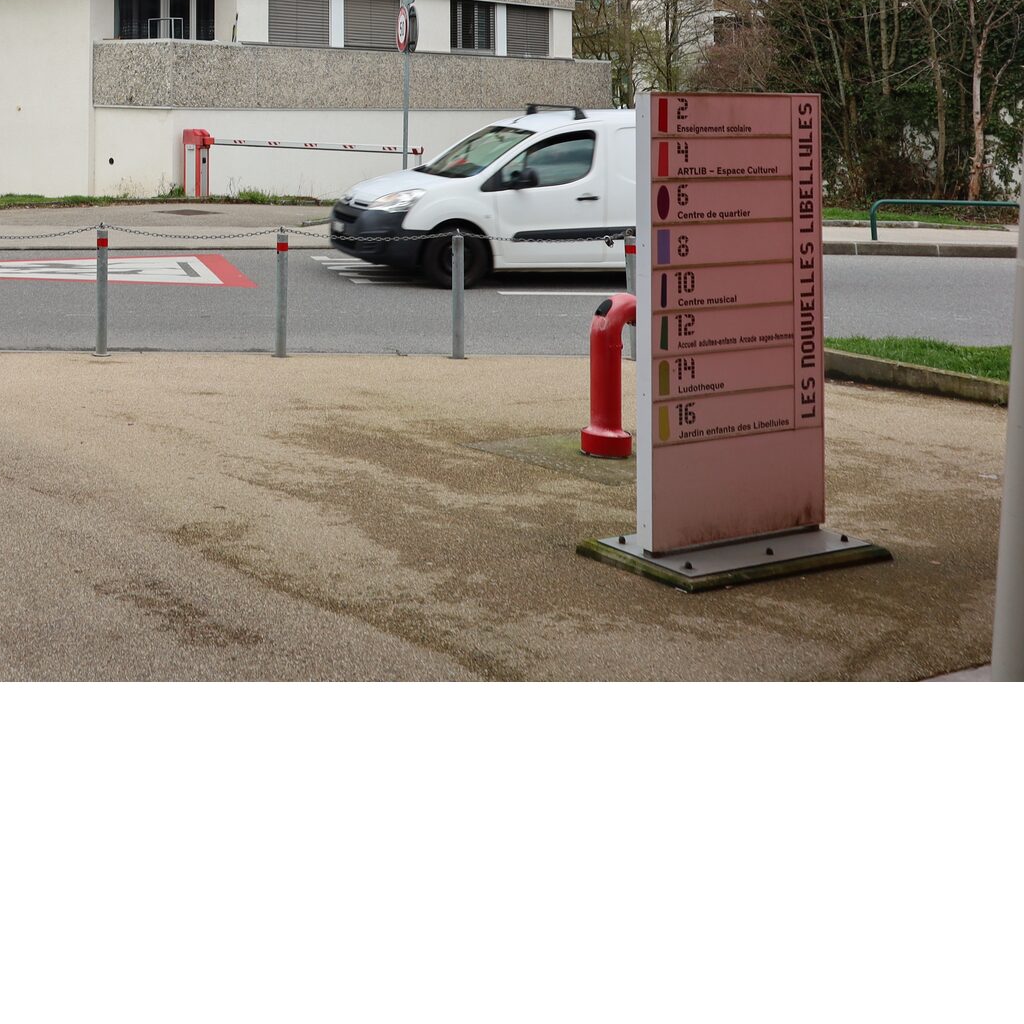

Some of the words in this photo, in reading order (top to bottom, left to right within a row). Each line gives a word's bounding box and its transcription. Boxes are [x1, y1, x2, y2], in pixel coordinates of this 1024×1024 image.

[677, 98, 688, 120] 2
[677, 125, 725, 133] Enseignement
[727, 125, 752, 133] scolaire
[677, 142, 688, 163] 4
[677, 167, 707, 176] ARTLIB
[717, 167, 745, 176] Espace
[747, 166, 778, 175] Culturel
[798, 102, 814, 233] LIBELLULES
[677, 184, 689, 206] 6
[677, 211, 705, 220] Centre
[706, 210, 717, 219] de
[719, 209, 751, 220] quartier
[677, 235, 689, 257] 8
[674, 271, 695, 294] 10
[678, 297, 705, 307] Centre
[706, 295, 737, 305] musical
[675, 314, 695, 336] 12
[678, 340, 696, 349] Accueil
[739, 335, 757, 344] Arcade
[675, 357, 695, 380] 14
[801, 377, 816, 419] LES
[675, 402, 696, 426] 16
[678, 429, 704, 439] Jardin
[706, 425, 736, 436] enfants
[737, 423, 751, 432] des
[754, 418, 790, 430] Libellules
